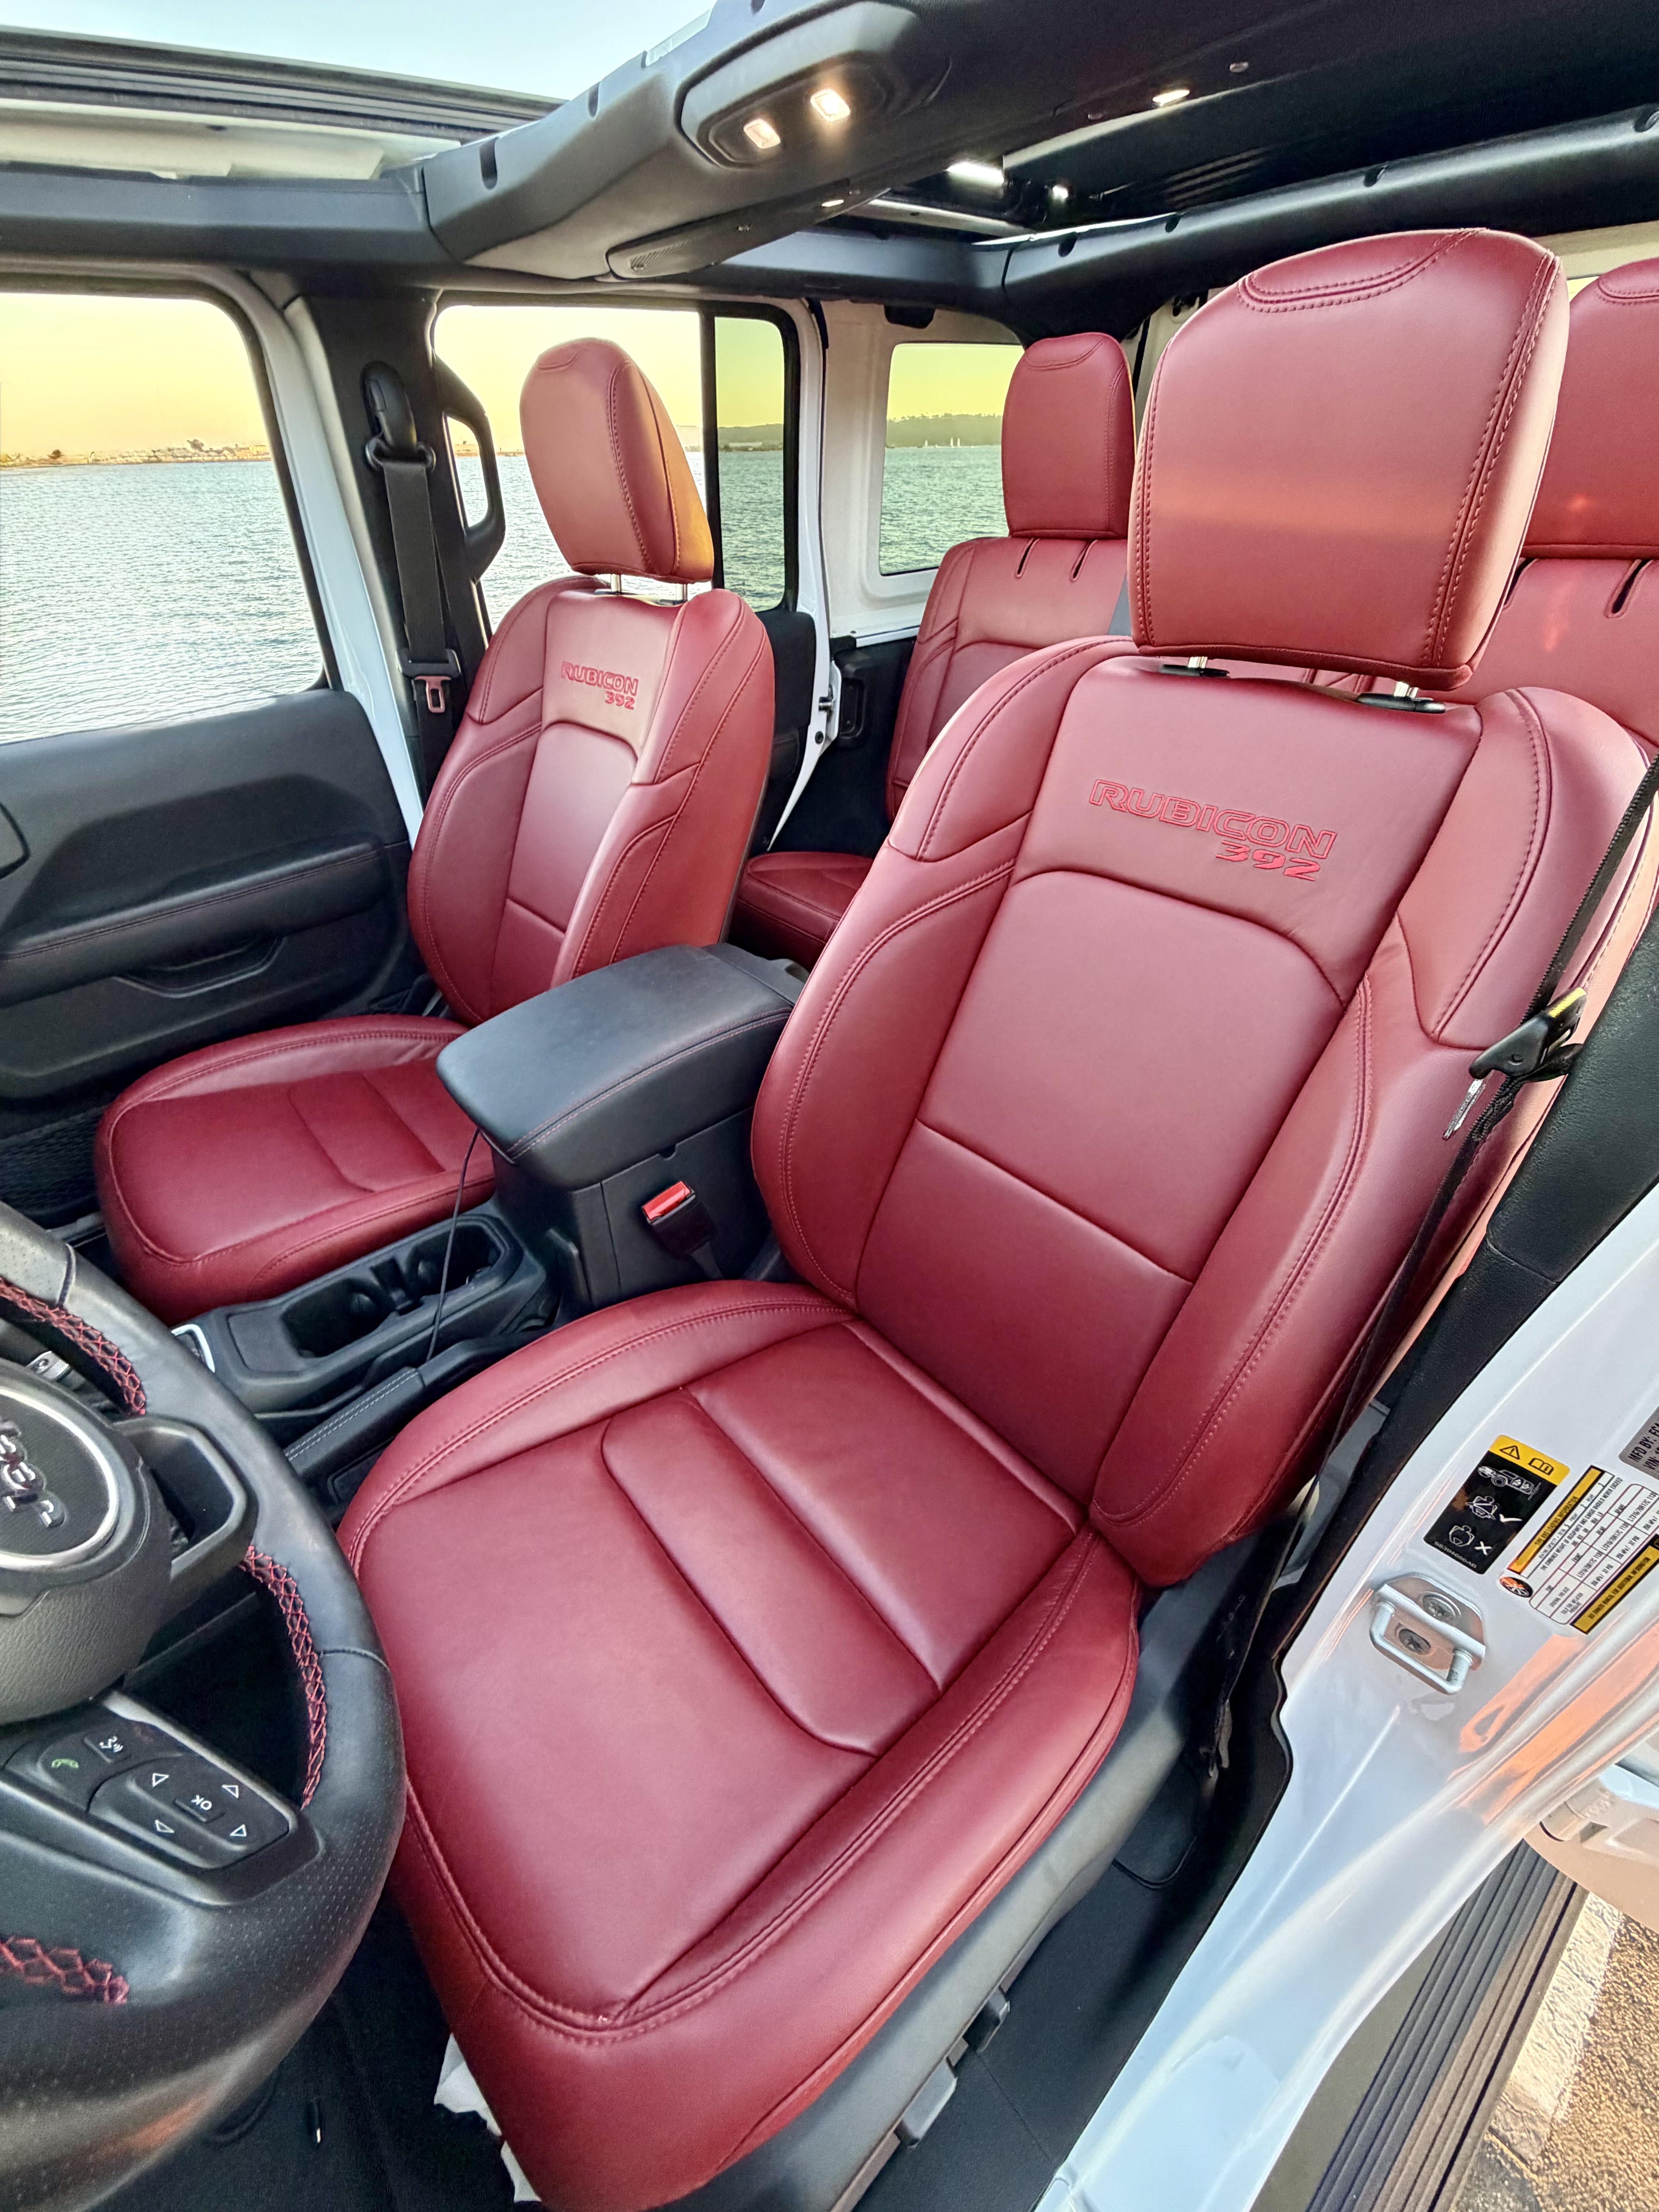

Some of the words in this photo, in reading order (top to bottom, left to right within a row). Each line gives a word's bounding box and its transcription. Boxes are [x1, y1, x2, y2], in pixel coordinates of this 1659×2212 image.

[562, 661, 639, 696] RUBICON
[605, 690, 635, 710] 392
[1089, 779, 1337, 859] RUBICON
[1216, 840, 1321, 881] 392
[1628, 1447, 1647, 1462] MFD
[1639, 1436, 1657, 1449] BY:
[191, 1795, 212, 1810] OK
